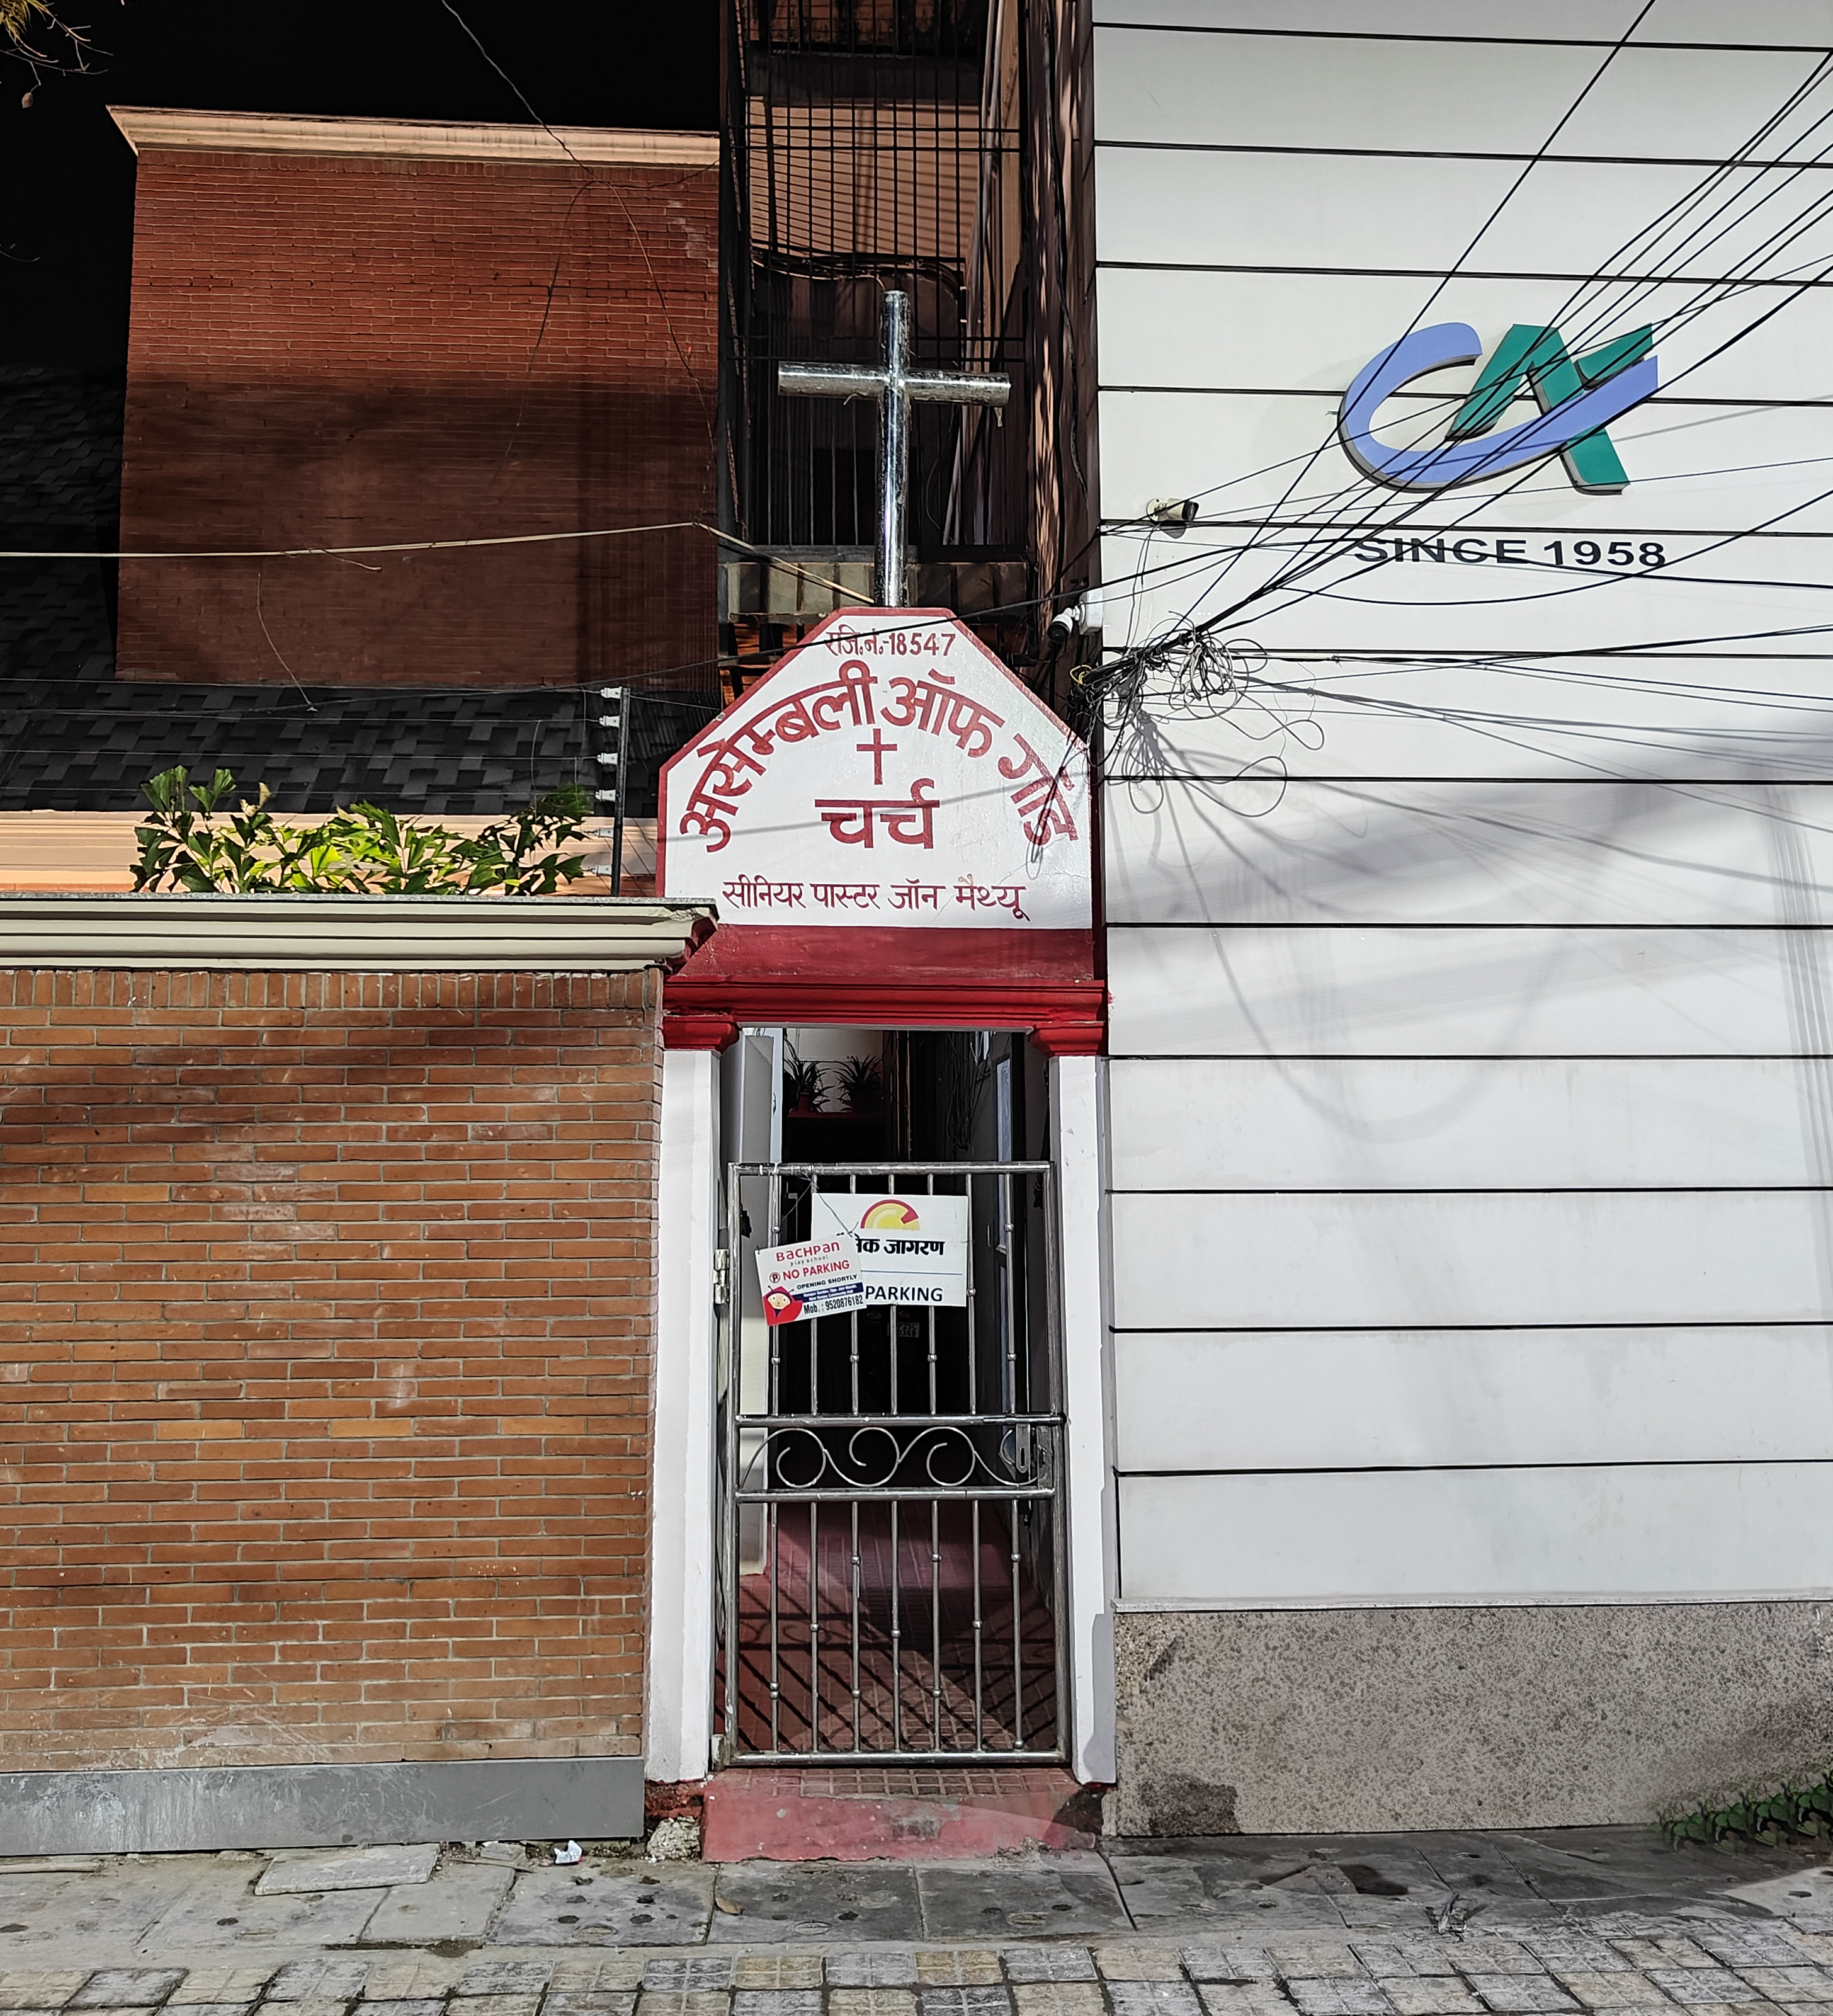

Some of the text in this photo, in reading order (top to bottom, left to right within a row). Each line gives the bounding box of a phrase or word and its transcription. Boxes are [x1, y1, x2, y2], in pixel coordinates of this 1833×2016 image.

[1354, 537, 1667, 567] SINCE 1958
[679, 659, 878, 853] असेम्बली
[814, 778, 940, 850] चर्च
[722, 874, 807, 909] सीनियर
[810, 883, 881, 911] पास्टर
[887, 879, 946, 911] जॉन
[883, 1239, 946, 1256] जागरण
[807, 1255, 829, 1263] school
[783, 1260, 850, 1281] NO PARKING
[797, 1274, 858, 1290] OPENING SHORTLY
[825, 1295, 864, 1311] 9520876182
[865, 1285, 943, 1302] PARKING
